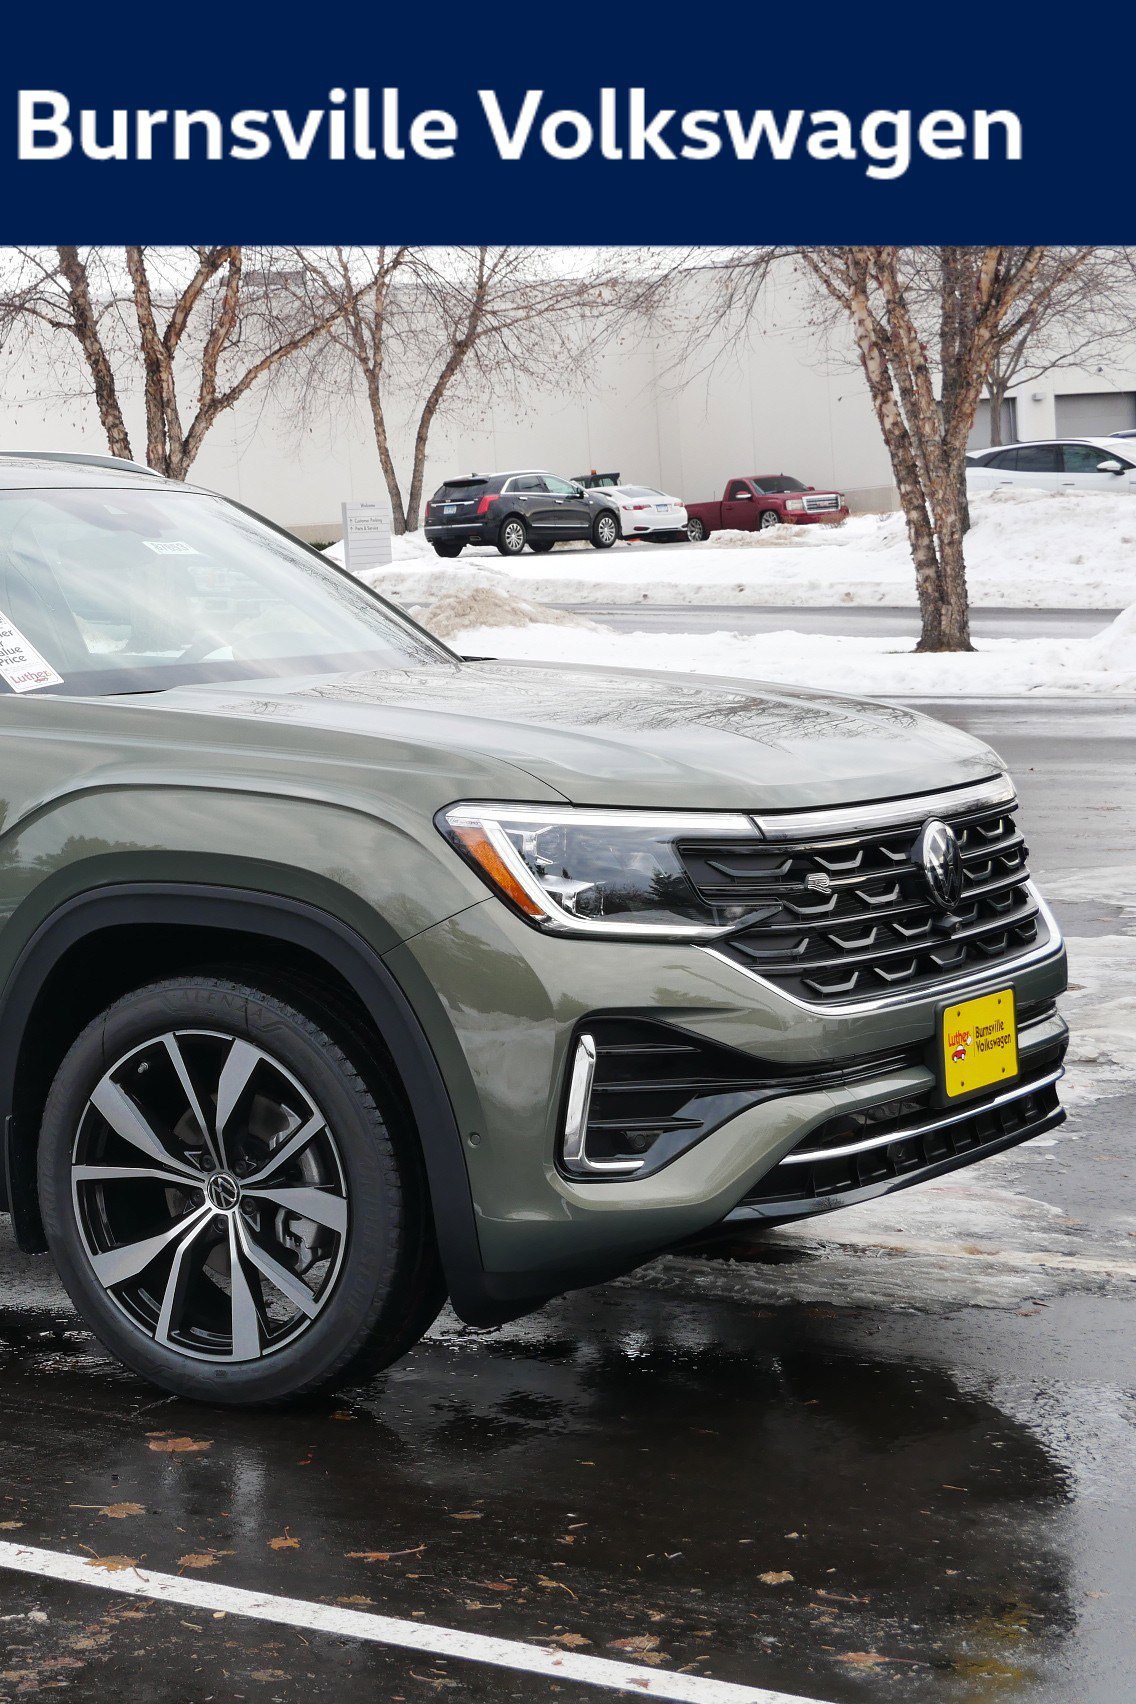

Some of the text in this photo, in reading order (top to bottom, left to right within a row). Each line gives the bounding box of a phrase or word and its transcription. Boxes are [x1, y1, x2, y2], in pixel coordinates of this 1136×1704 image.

[10, 670, 51, 684] Luther
[975, 1019, 1005, 1039] Burnsville
[948, 1030, 970, 1047] Luther
[975, 1033, 1012, 1053] Volkswagen
